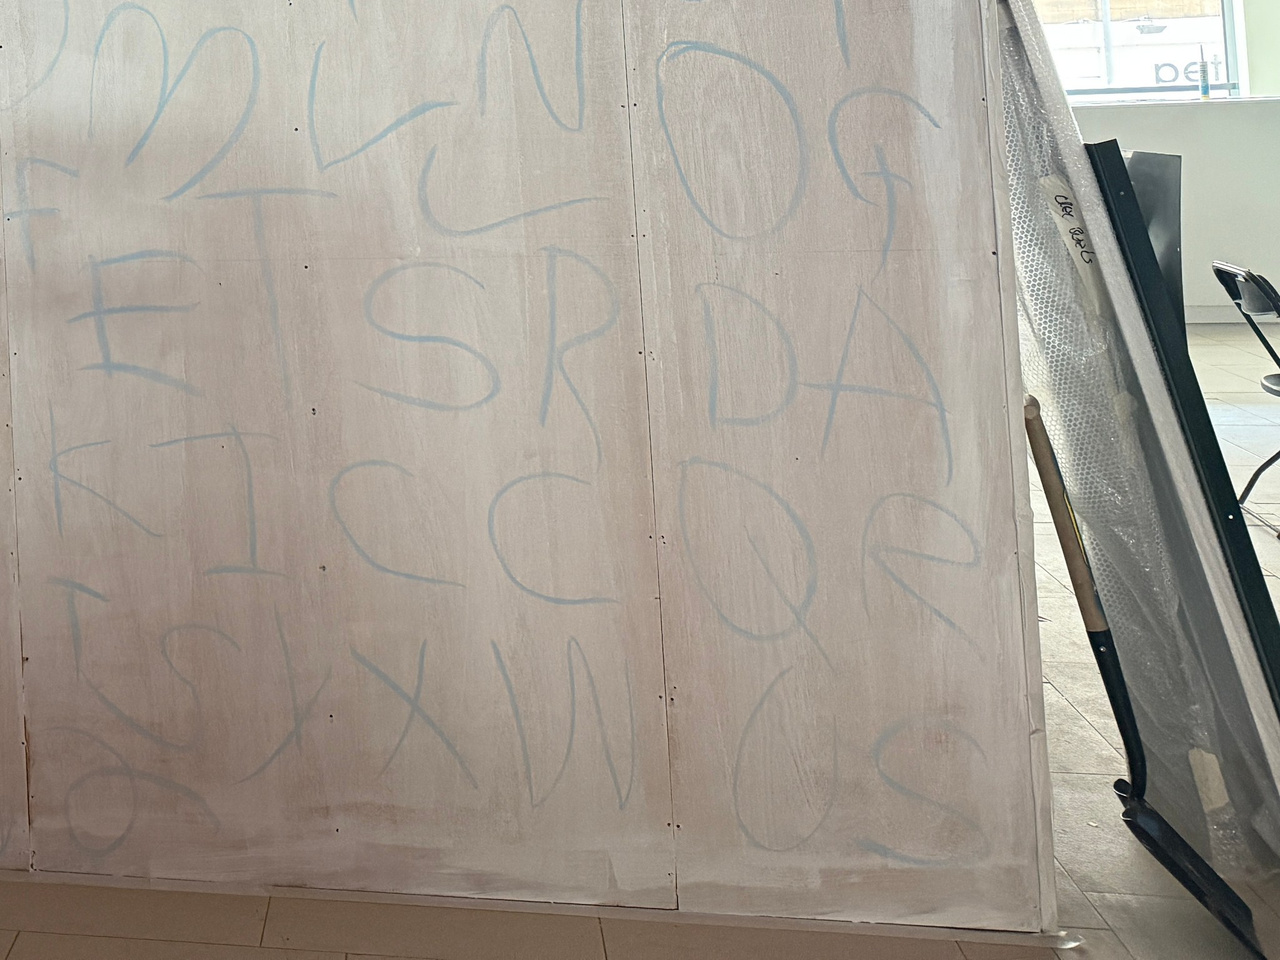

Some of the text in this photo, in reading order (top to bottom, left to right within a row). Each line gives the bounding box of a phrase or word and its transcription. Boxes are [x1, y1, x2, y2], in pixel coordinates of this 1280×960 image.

[3, 157, 78, 270] F
[68, 248, 201, 396] E
[360, 258, 501, 412] S
[536, 244, 620, 465] R
[695, 283, 798, 428] D
[805, 285, 954, 485] A
[48, 410, 162, 538] K
[352, 639, 478, 790] X
